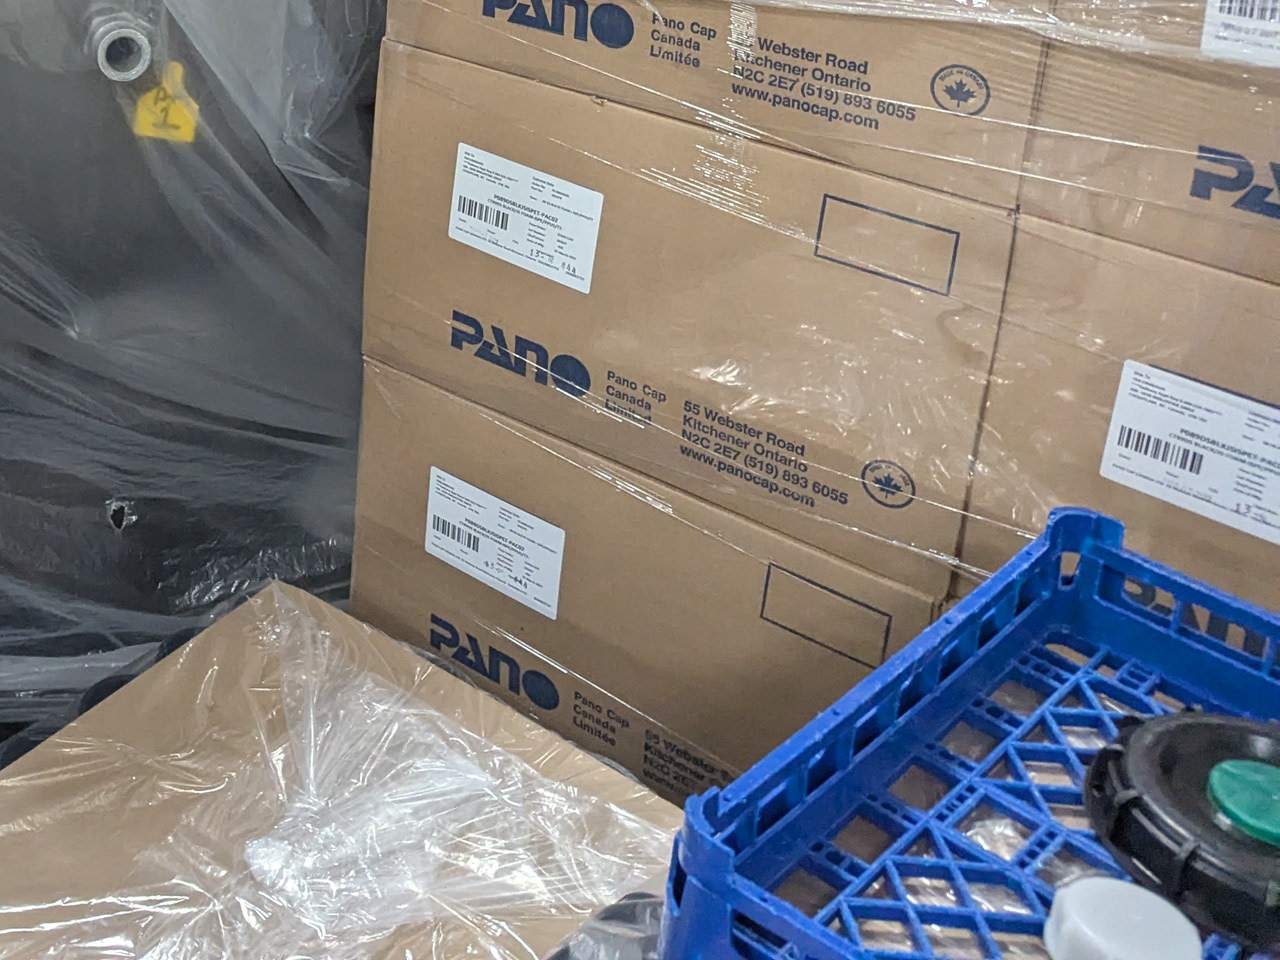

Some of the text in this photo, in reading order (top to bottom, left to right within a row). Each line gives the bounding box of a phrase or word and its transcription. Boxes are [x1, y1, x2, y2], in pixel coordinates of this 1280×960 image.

[651, 30, 701, 51] Canada
[690, 21, 717, 40] Cap
[757, 37, 822, 63] Webster
[825, 53, 869, 75] Road
[733, 64, 916, 121] N2C 2E7 (519) 893 6055
[811, 68, 871, 92] Ontario
[732, 83, 879, 129] www.panocap.com
[606, 385, 652, 411] Canada
[607, 370, 667, 403] Pano Cap
[683, 400, 805, 457] 55 Webster Road
[683, 415, 808, 473] Kitchener Ontario
[679, 445, 815, 508] www.panocap.com
[681, 429, 848, 505] N2C 2E7 (519) 893 6055
[430, 613, 560, 710] PANO
[573, 704, 616, 734] Canada
[574, 691, 629, 728] Pano Cap
